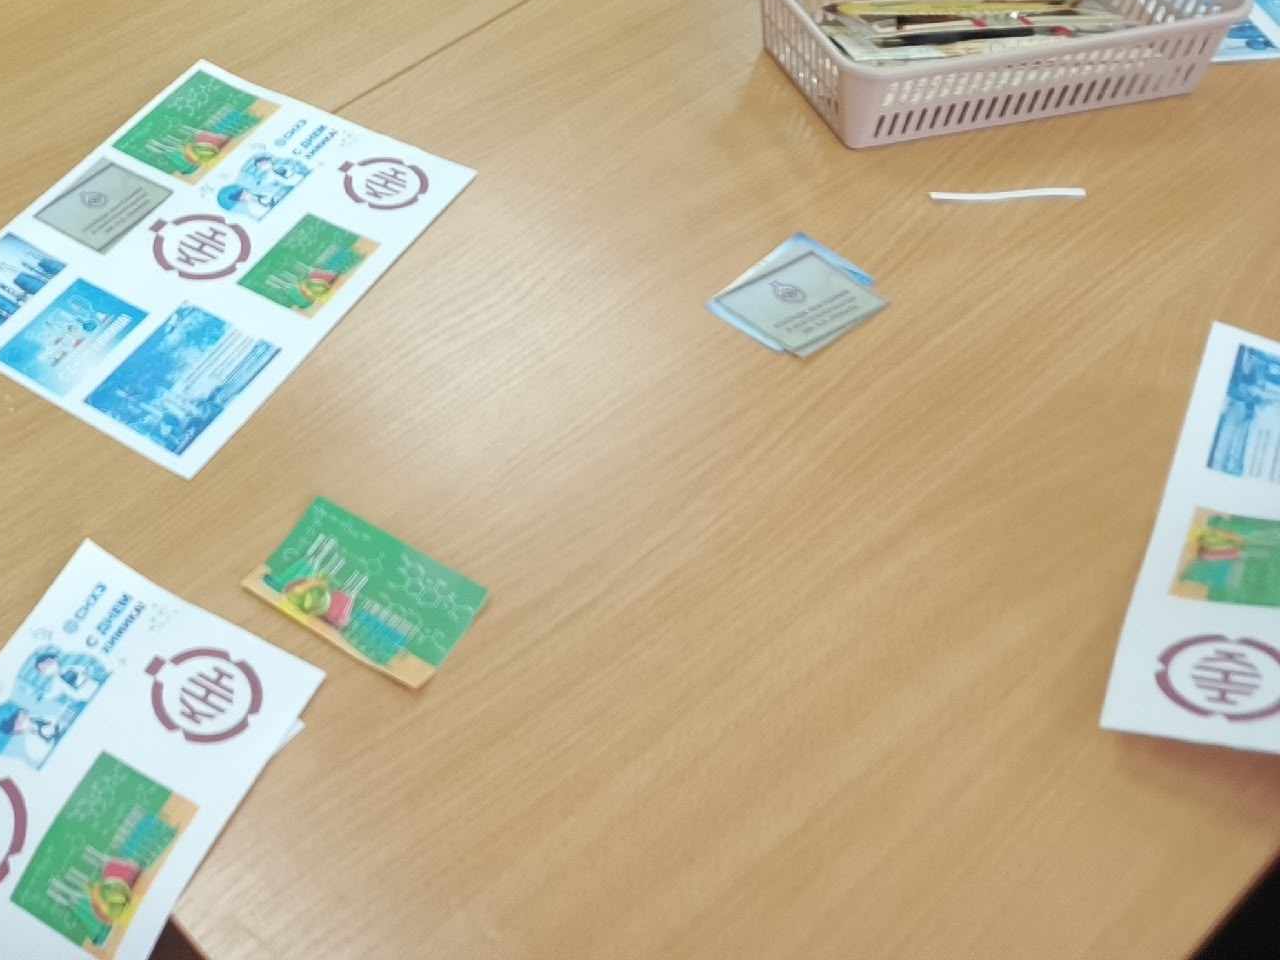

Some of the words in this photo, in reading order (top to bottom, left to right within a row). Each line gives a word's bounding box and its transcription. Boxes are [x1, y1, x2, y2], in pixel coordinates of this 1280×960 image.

[291, 146, 302, 157] С
[365, 167, 407, 200] КНН
[177, 227, 227, 267] КНН
[83, 633, 98, 649] С
[179, 667, 234, 724] КНН
